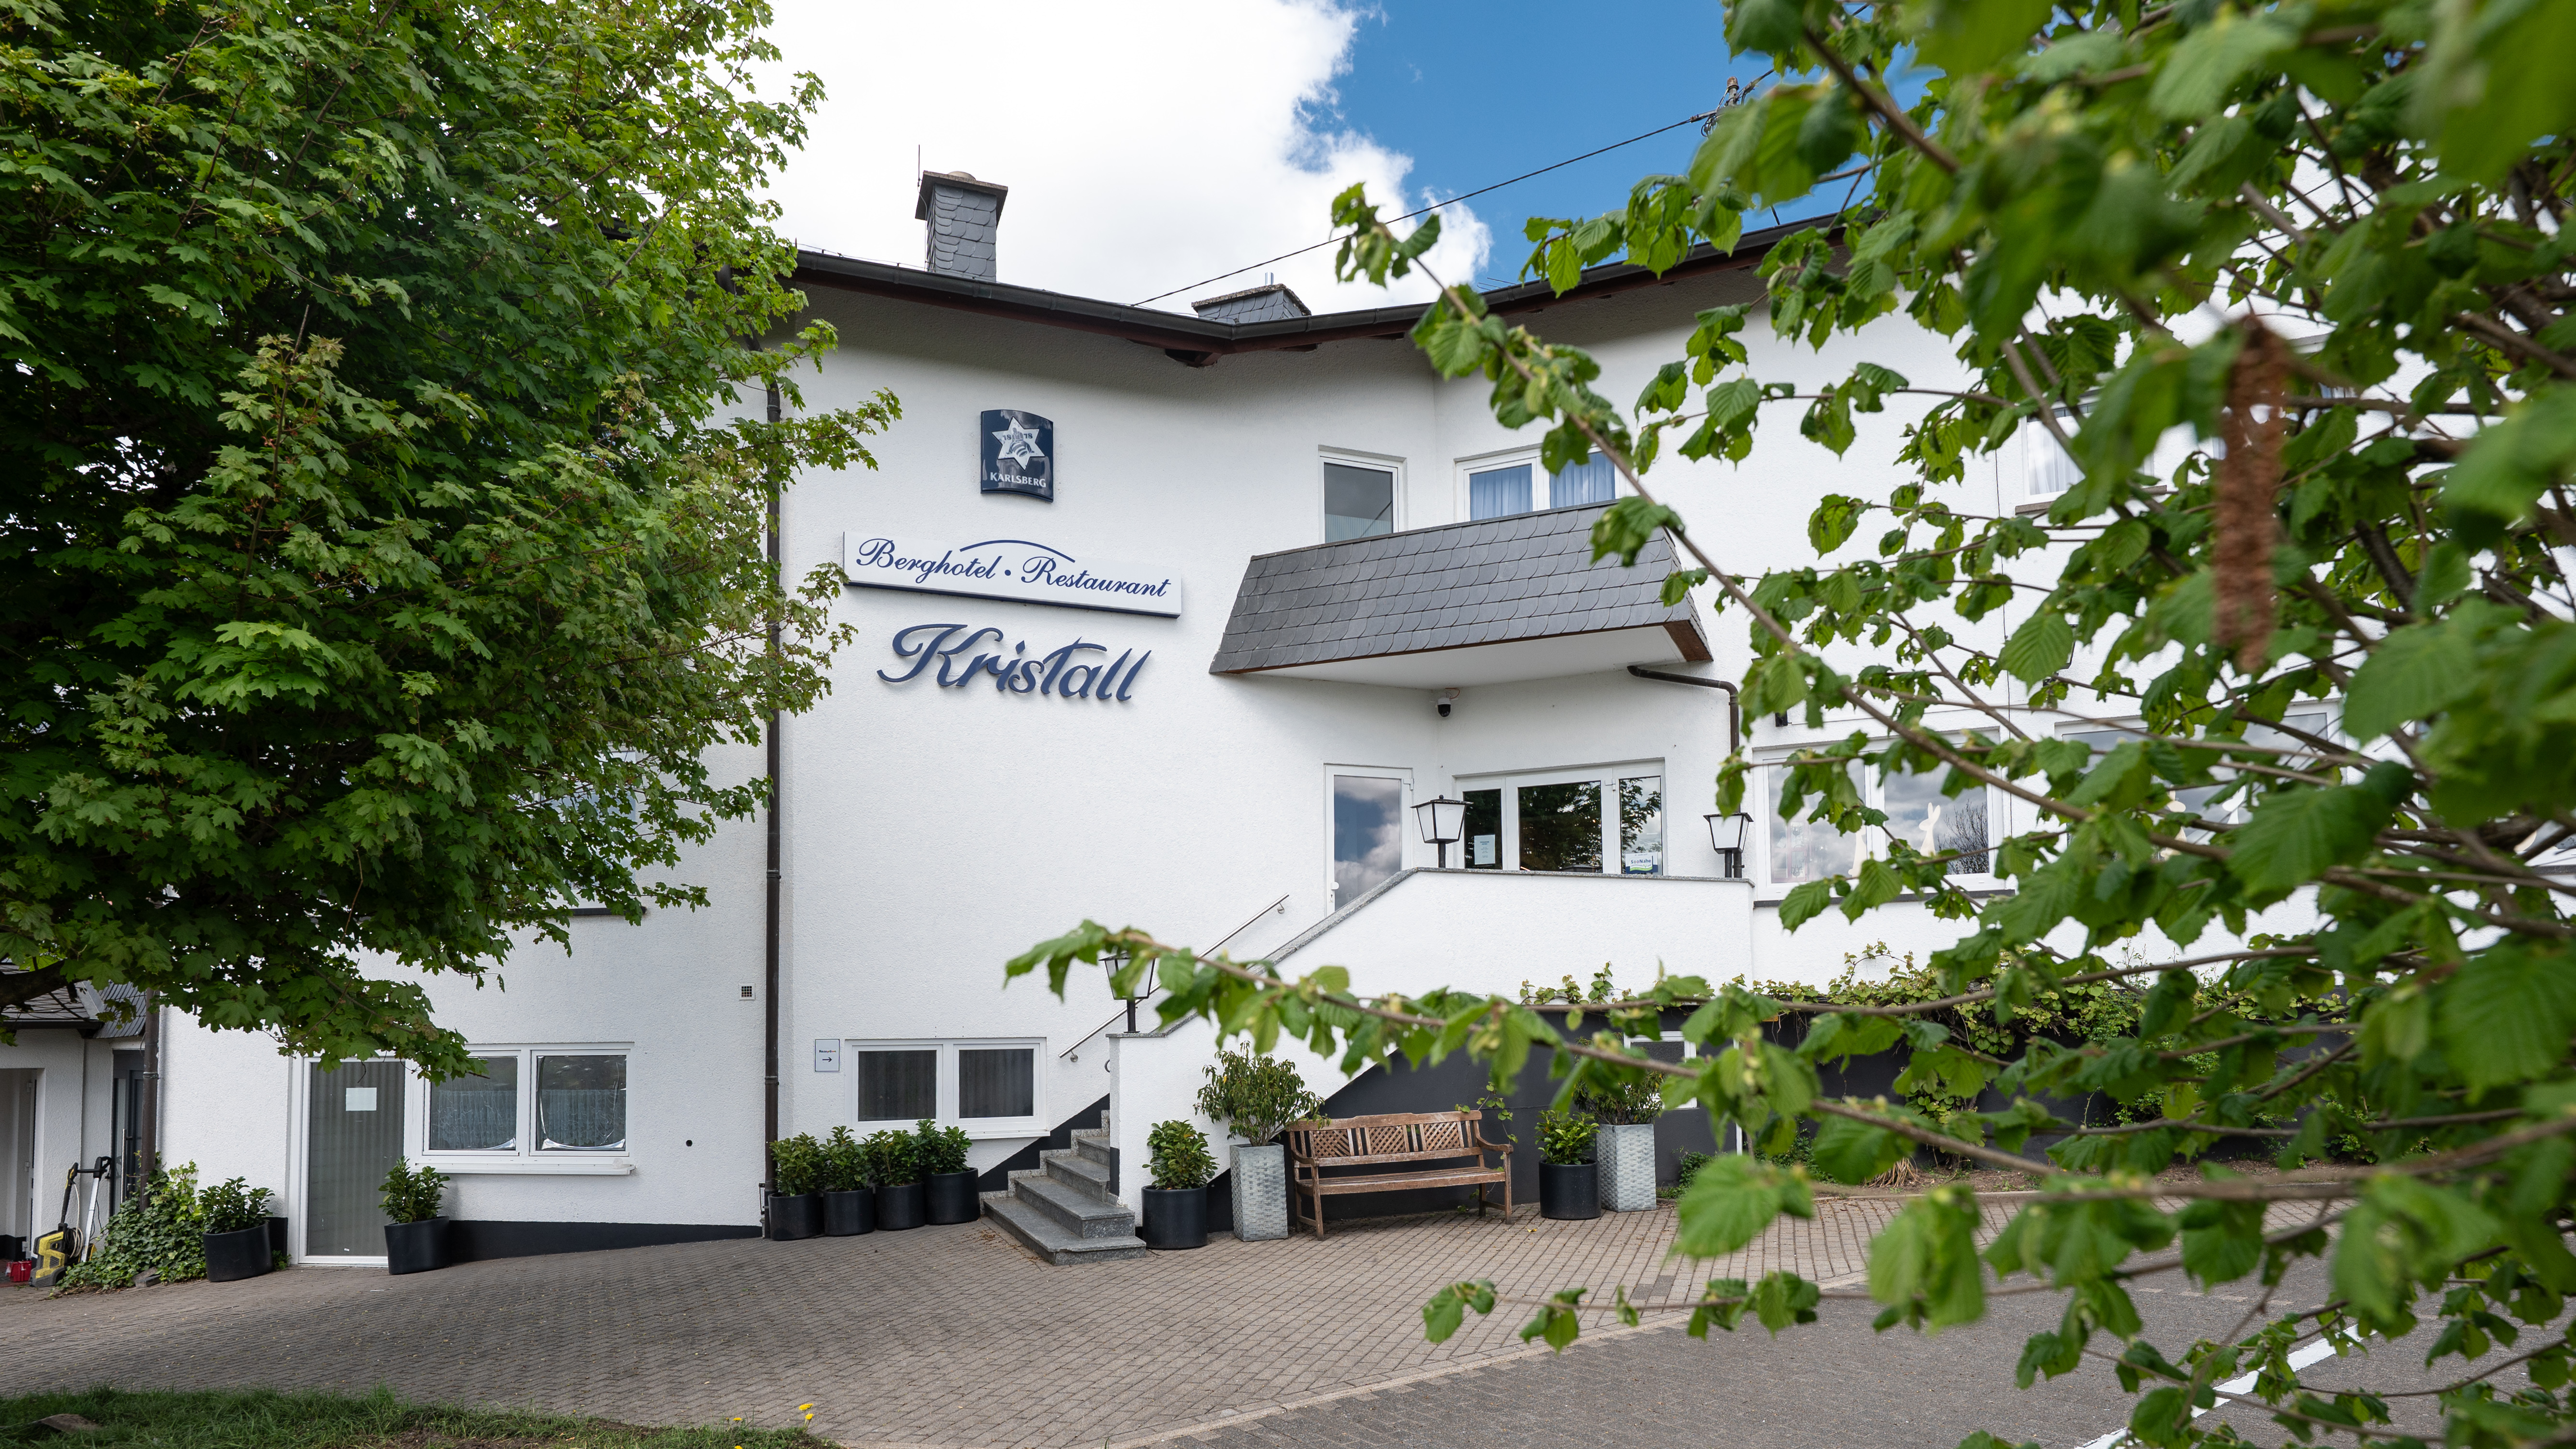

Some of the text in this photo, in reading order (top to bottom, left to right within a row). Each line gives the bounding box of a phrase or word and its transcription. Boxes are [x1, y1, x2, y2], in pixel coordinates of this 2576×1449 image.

[990, 472, 1046, 488] KARLSBERG
[856, 538, 1171, 598] Berghotel Restaurant
[876, 623, 1152, 702] Kristall
